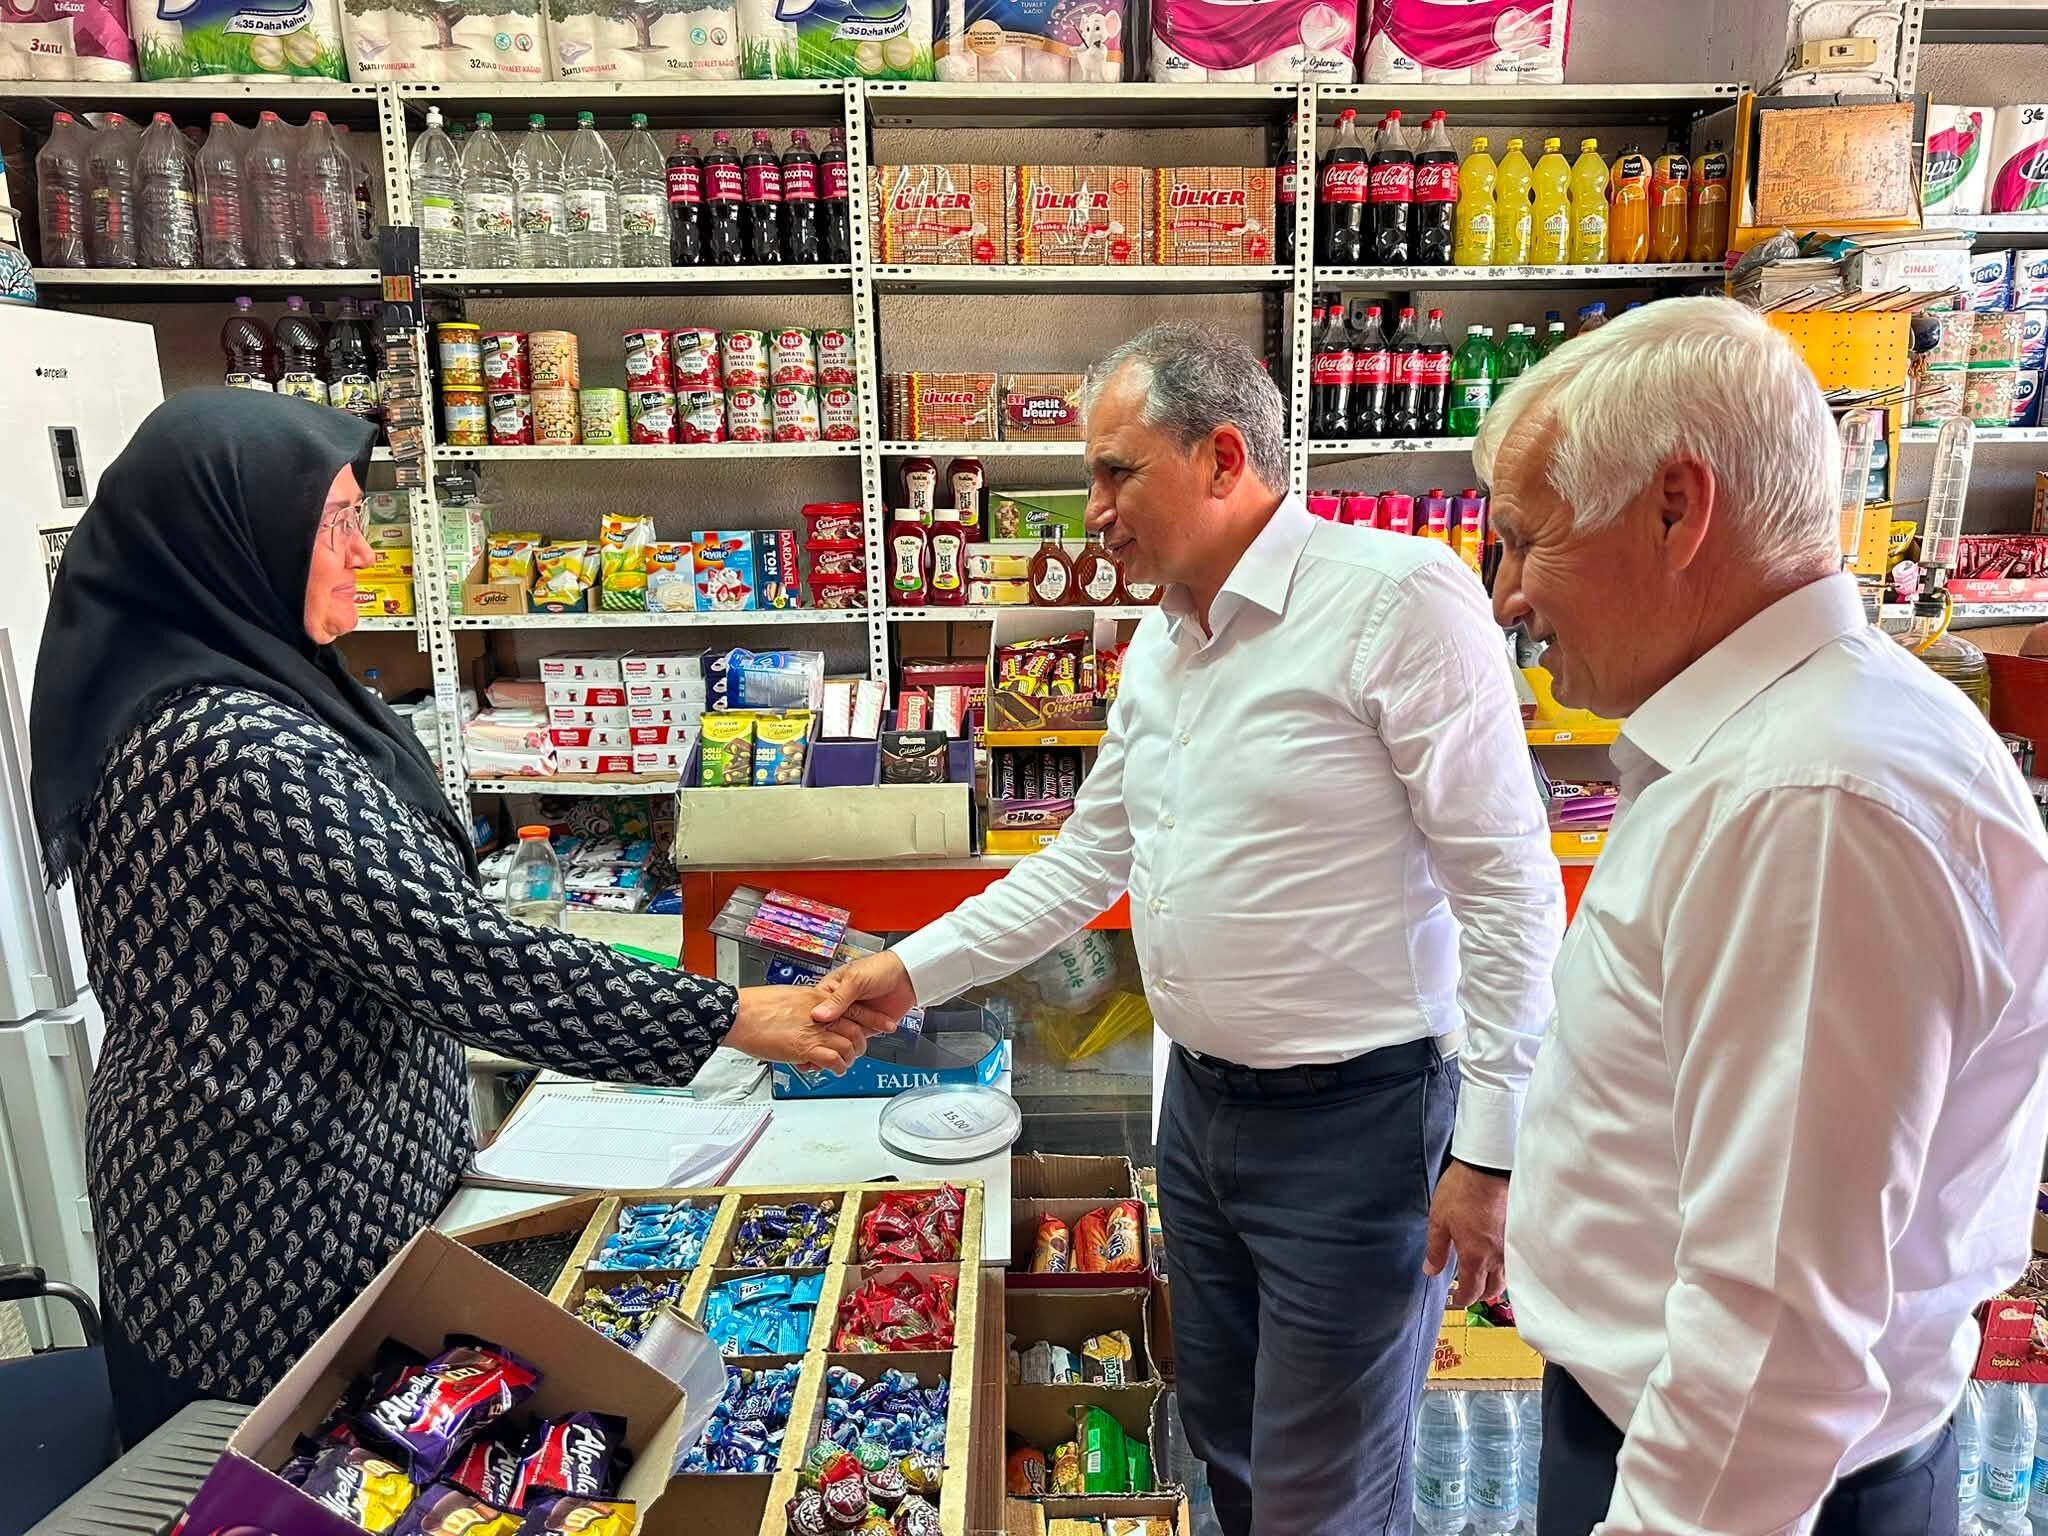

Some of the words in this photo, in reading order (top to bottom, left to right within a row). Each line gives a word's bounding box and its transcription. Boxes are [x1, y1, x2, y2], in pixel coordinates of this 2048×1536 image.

[256, 19, 282, 31] Daha
[893, 186, 976, 211] ÜLKER
[1168, 183, 1248, 207] ÜLKER
[1971, 263, 2001, 284] Teno
[922, 388, 975, 405] ÜLKER
[1028, 398, 1061, 411] petit
[1022, 407, 1067, 418] beurre
[766, 550, 778, 576] TON
[780, 531, 795, 587] DARDANEL
[876, 1072, 940, 1089] FALIM
[739, 1282, 764, 1297] First
[379, 1373, 434, 1429] Alpella
[574, 1423, 606, 1496] Alpella
